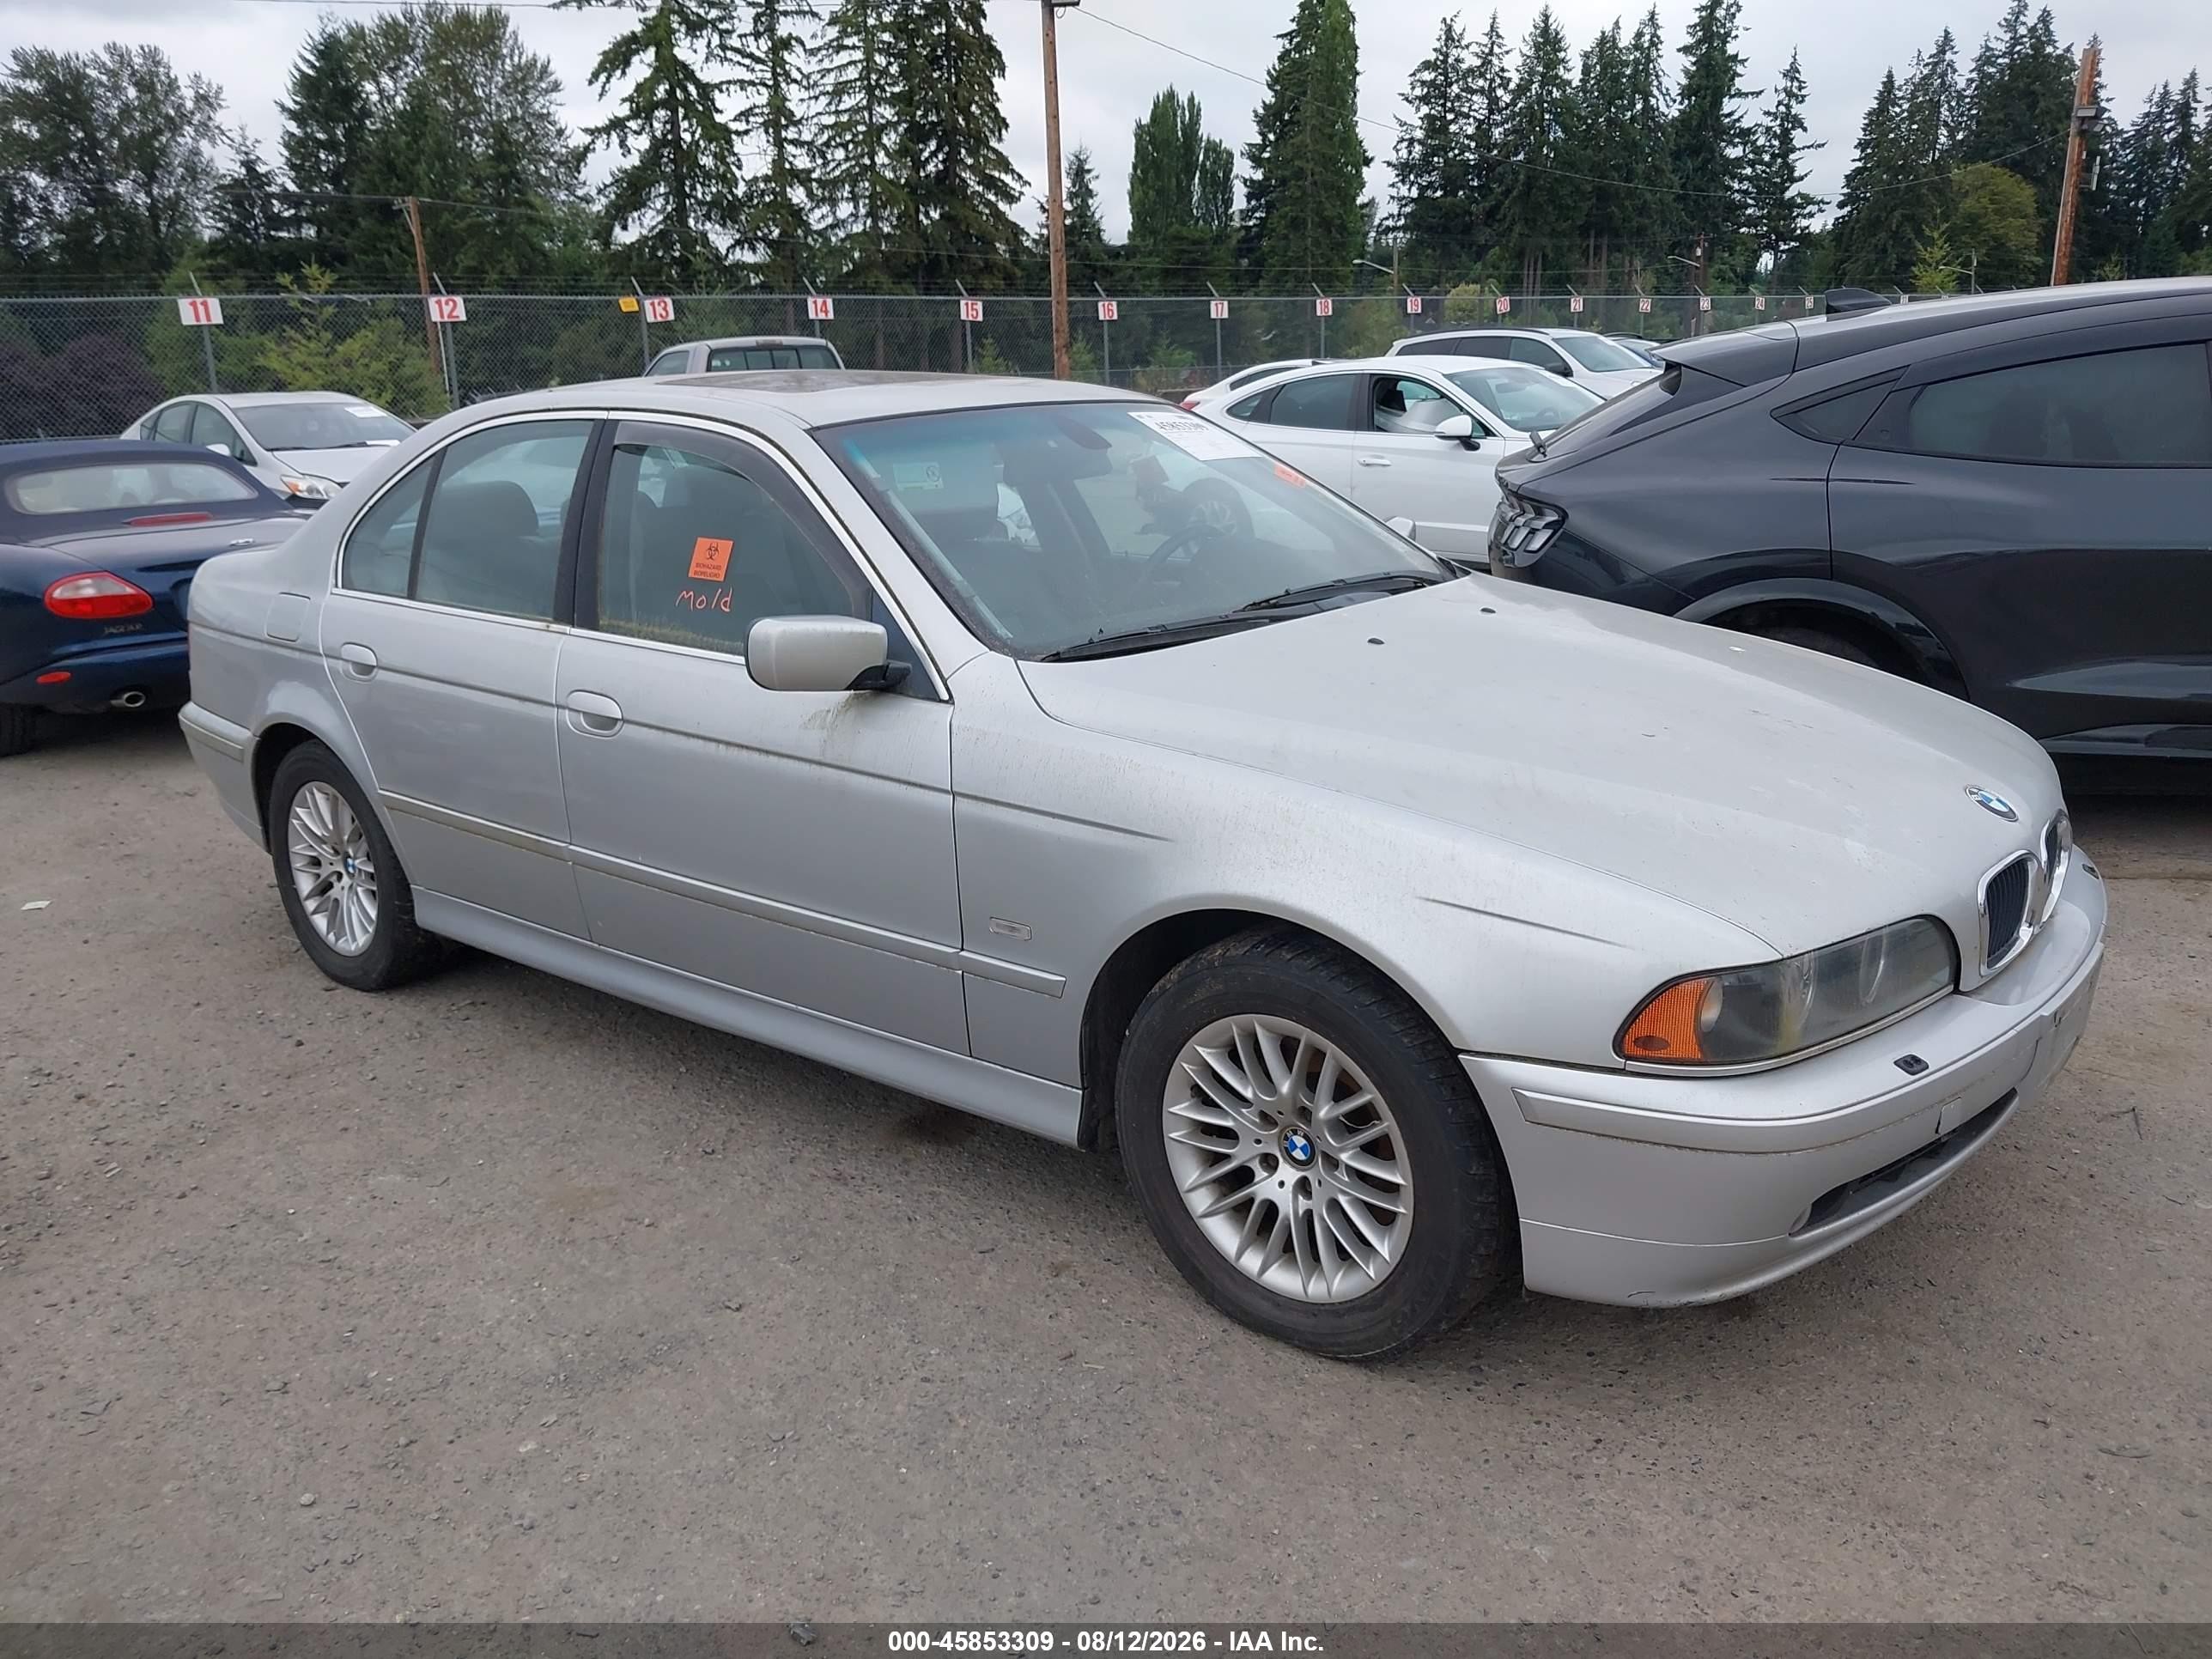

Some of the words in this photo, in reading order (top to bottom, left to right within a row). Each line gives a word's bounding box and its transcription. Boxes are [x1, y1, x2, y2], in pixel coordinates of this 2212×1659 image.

[189, 300, 212, 322] 11
[434, 298, 460, 319] 12
[650, 300, 670, 319] 13
[812, 299, 830, 318] 14
[964, 301, 979, 319] 15
[1103, 302, 1115, 319] 16
[1215, 302, 1224, 318] 17
[1319, 300, 1330, 315] 18
[1410, 298, 1419, 313] 19
[1498, 298, 1509, 312] 20
[1572, 297, 1581, 311] 21
[1640, 299, 1650, 311] 22
[1701, 298, 1710, 309] 23
[1756, 297, 1765, 309] 24
[675, 586, 732, 612] Mold
